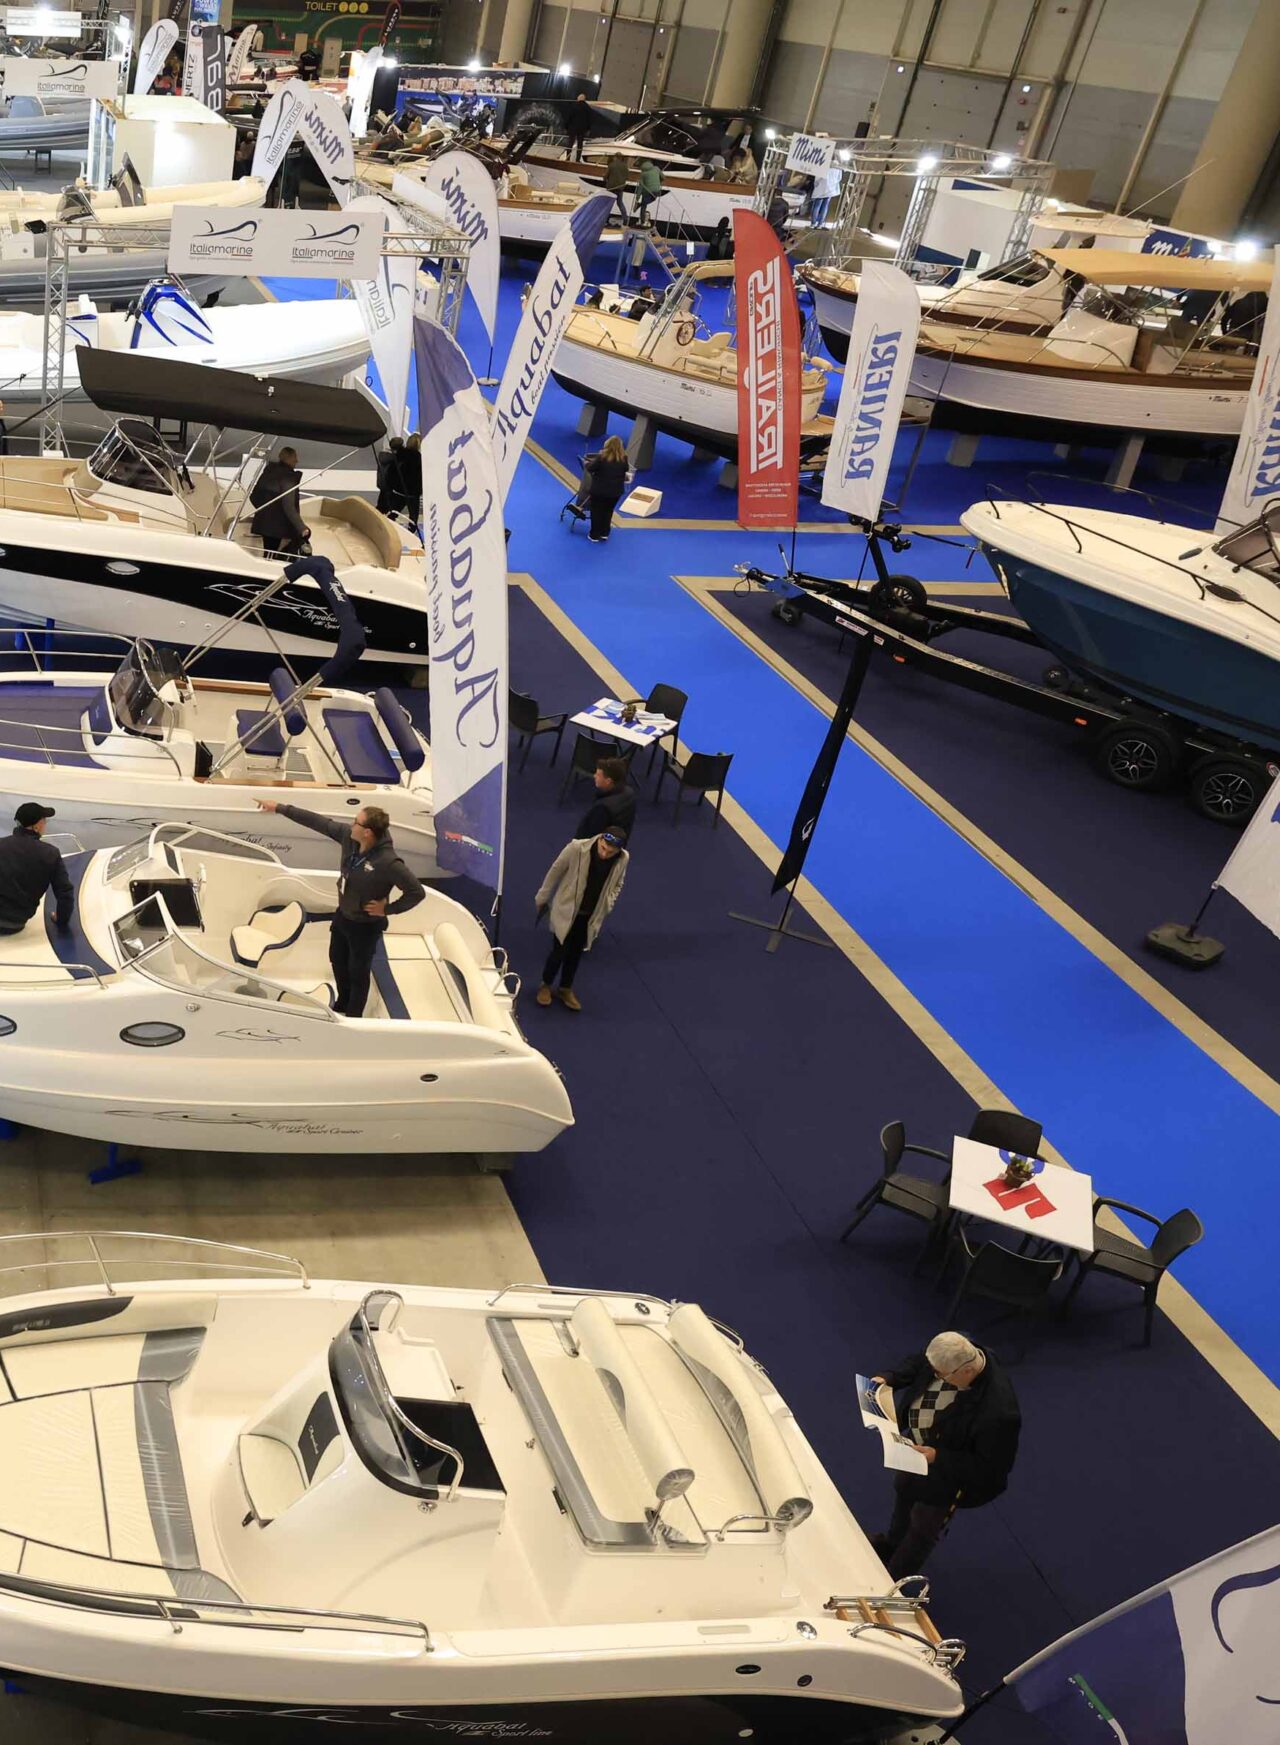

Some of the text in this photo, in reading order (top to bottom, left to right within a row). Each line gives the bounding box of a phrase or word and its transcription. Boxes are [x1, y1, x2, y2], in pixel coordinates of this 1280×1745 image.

[305, 2, 338, 11] TOILET
[38, 82, 86, 91] Italiamarine
[267, 101, 303, 164] Italiamarine
[189, 243, 253, 255] Italiamarine
[292, 247, 356, 258] Italiamarine
